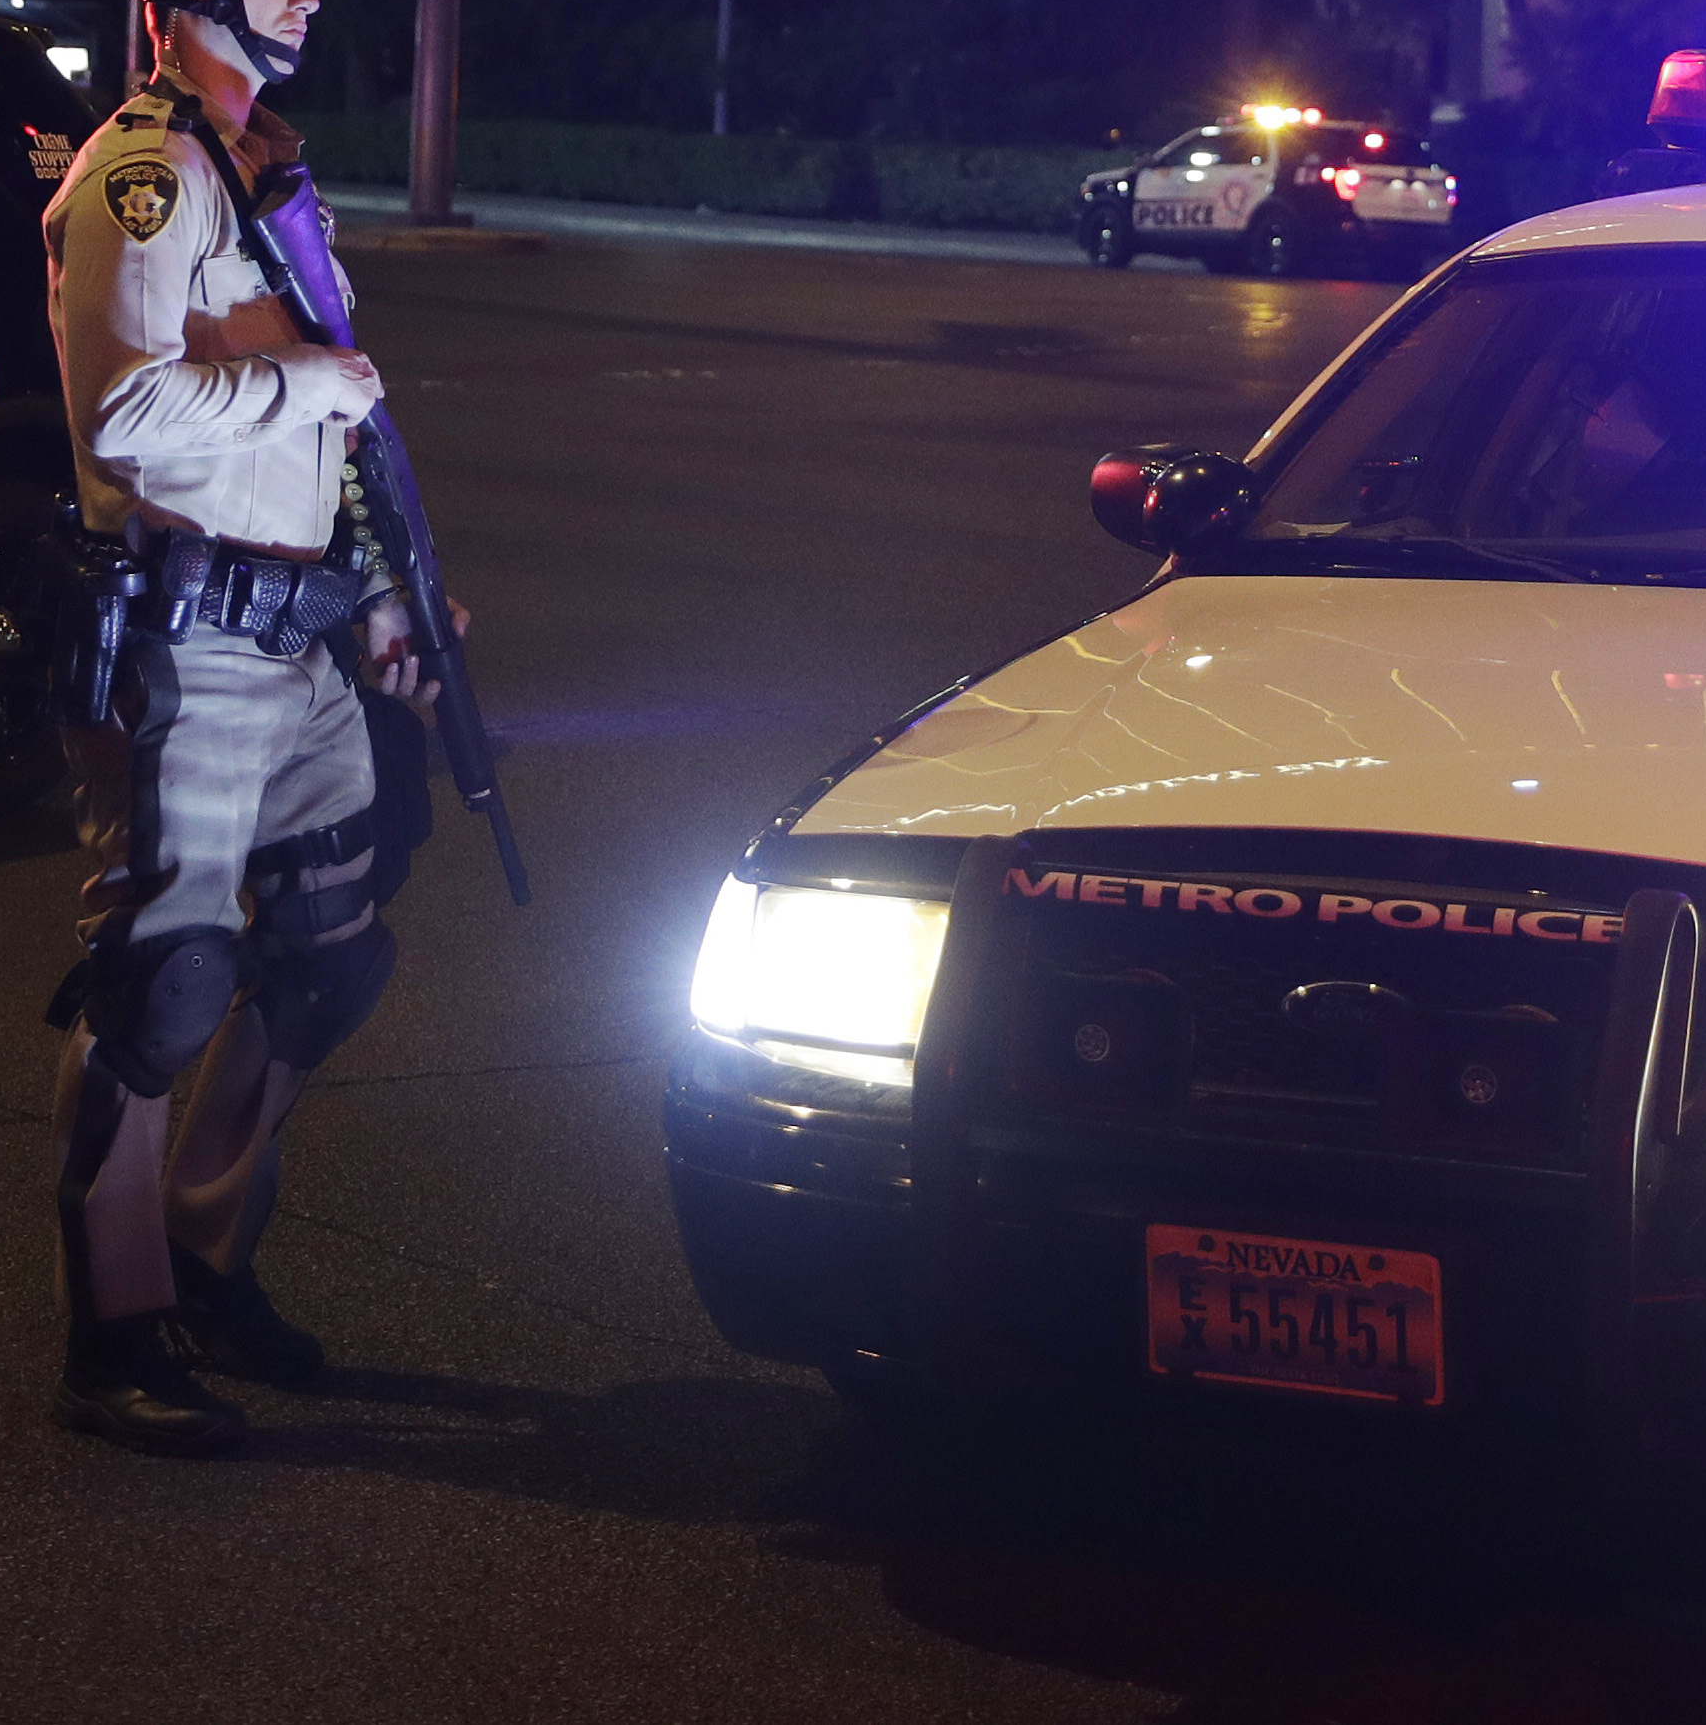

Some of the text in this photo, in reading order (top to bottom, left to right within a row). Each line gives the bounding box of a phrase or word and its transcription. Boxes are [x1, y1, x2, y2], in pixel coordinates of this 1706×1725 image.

[1137, 203, 1214, 225] POLICE
[1001, 868, 1625, 944] METRO POLICE
[1225, 1240, 1362, 1282] NEVADA
[1229, 1281, 1419, 1375] 55451
